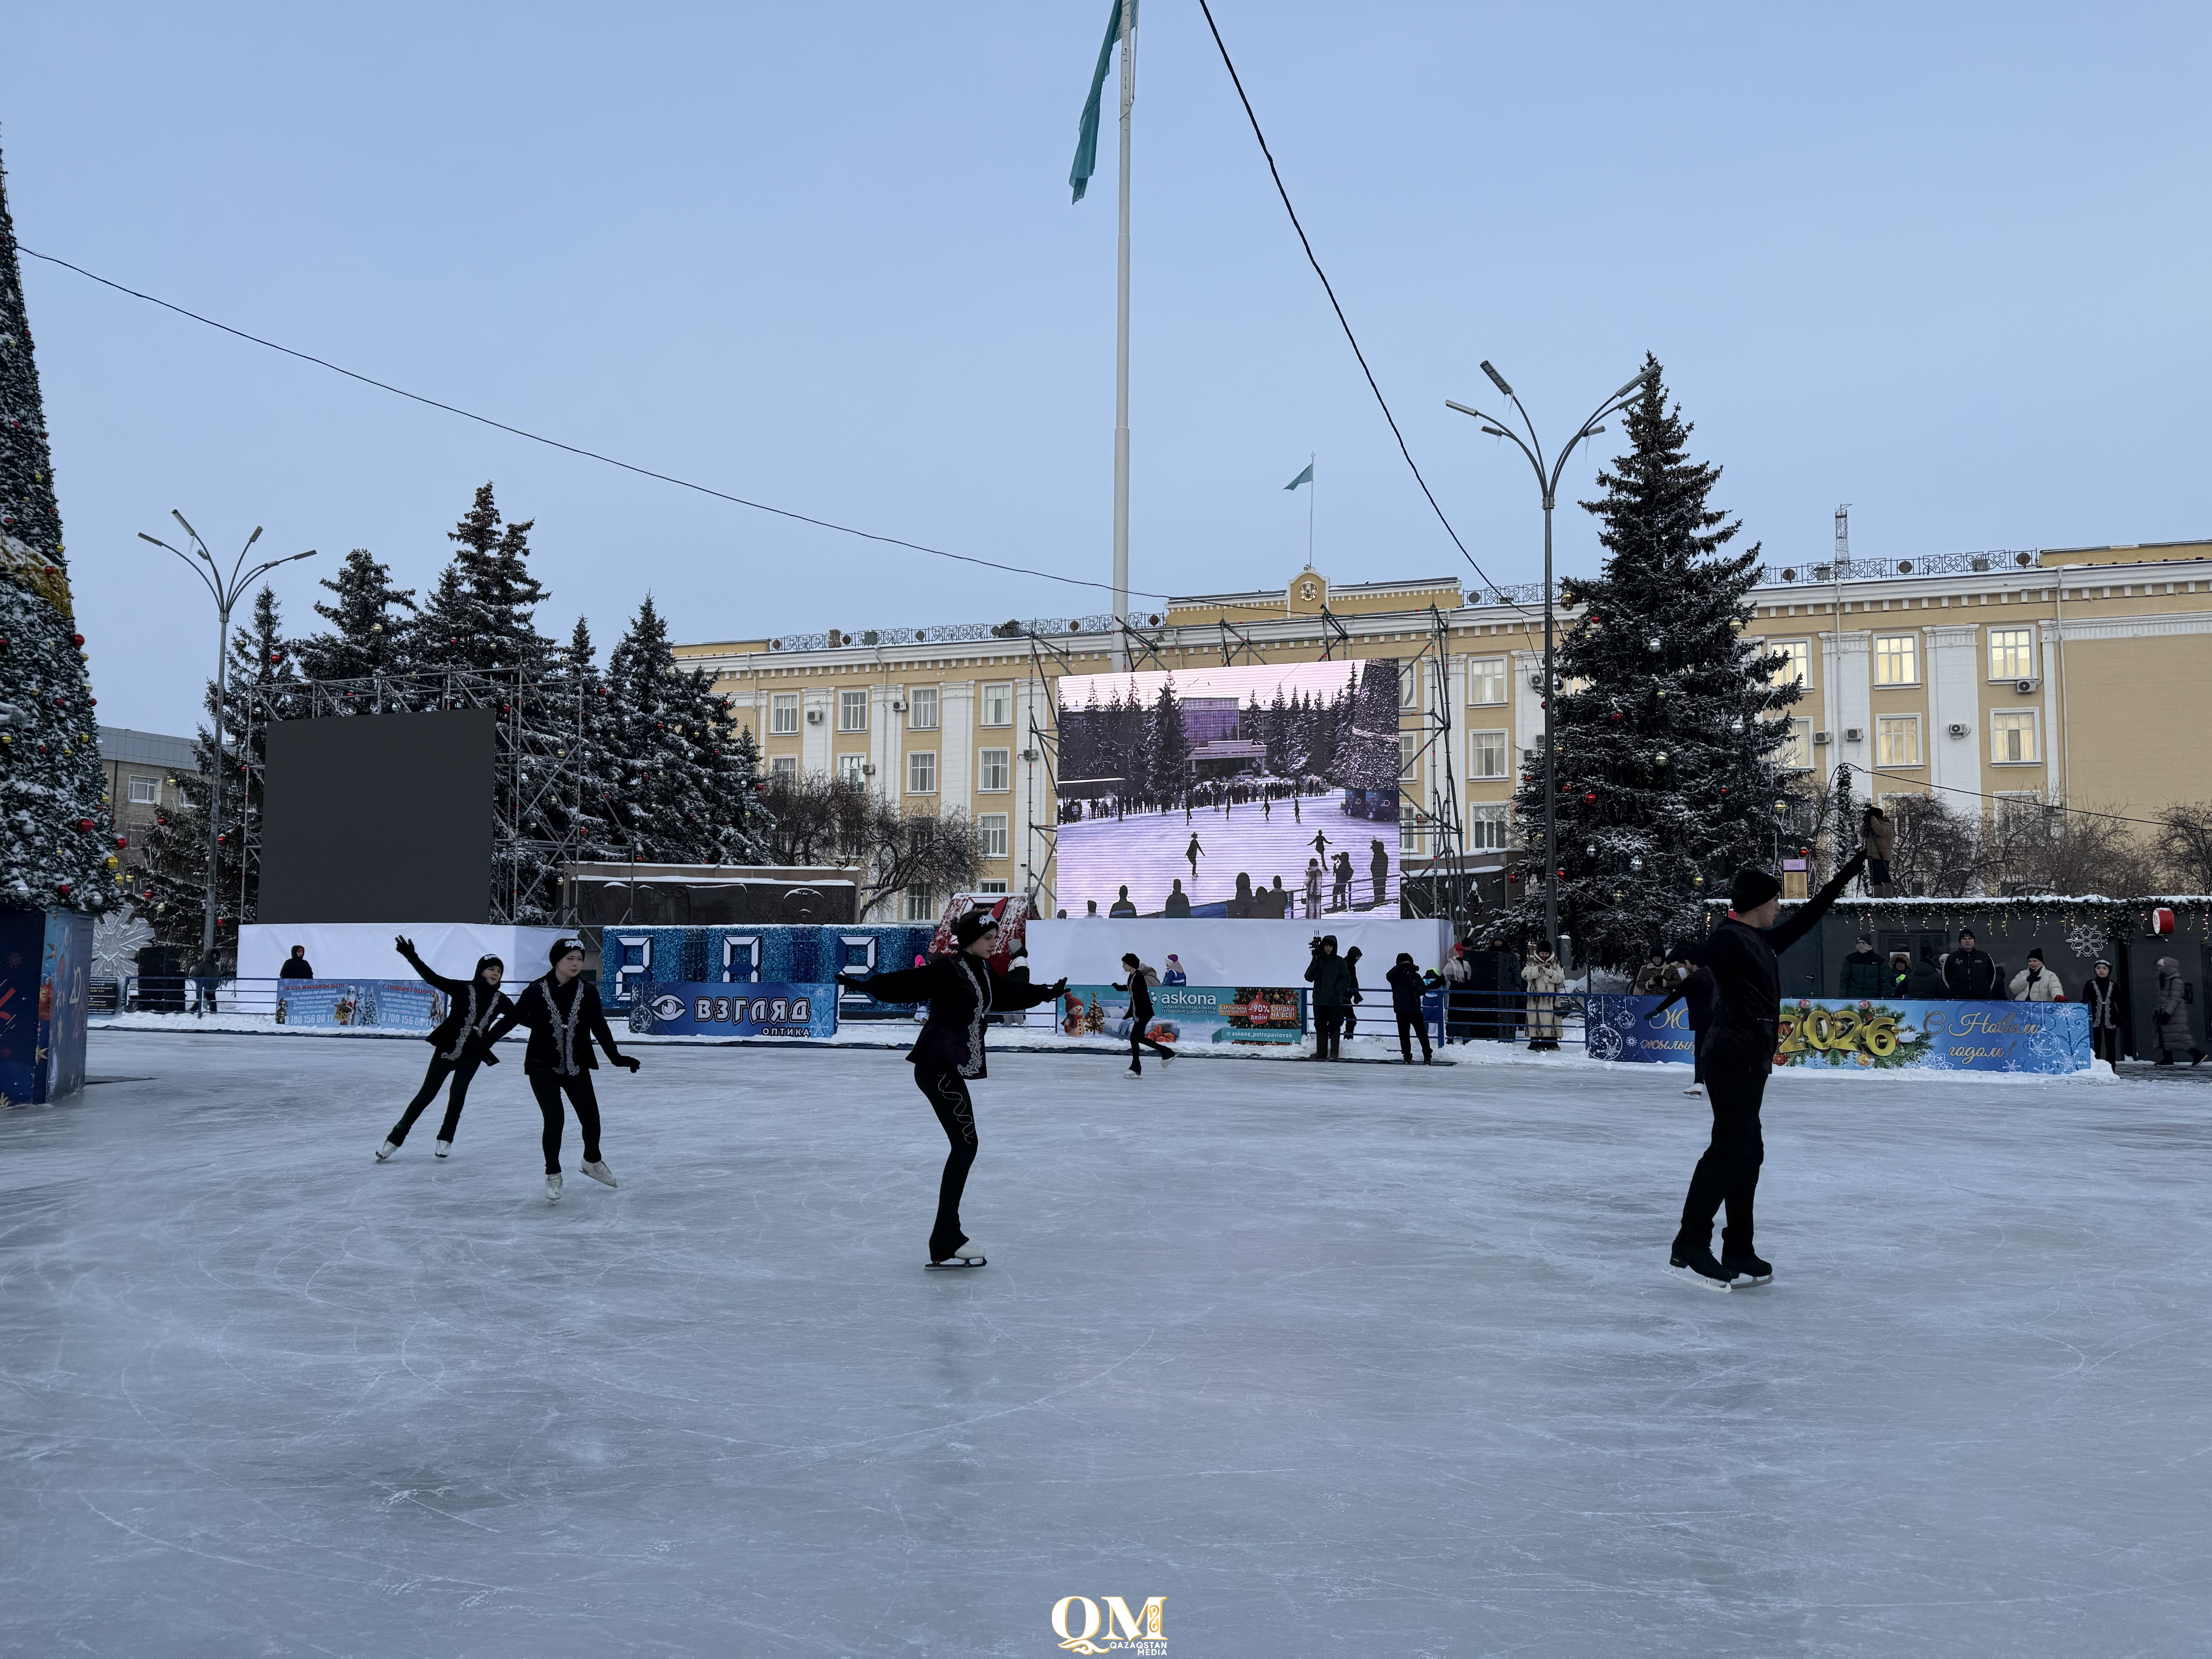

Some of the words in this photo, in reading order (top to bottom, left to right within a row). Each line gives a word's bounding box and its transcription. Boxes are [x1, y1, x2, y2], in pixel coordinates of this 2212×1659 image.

[1161, 990, 1216, 1005] askona
[695, 996, 811, 1025] ВЗГЛЯД
[1249, 1004, 1270, 1013] -90%
[304, 1015, 315, 1024] 156
[316, 1014, 325, 1023] 00
[327, 1014, 333, 1023] 11
[381, 1013, 386, 1022] 8
[388, 1013, 400, 1024] 700
[402, 1015, 413, 1025] 156
[1923, 1010, 1946, 1035] С
[1948, 1010, 2039, 1037] Новым
[763, 1027, 810, 1037] ОПТИКА
[1779, 1010, 1896, 1057] 2026
[1947, 1041, 2018, 1065] годом!
